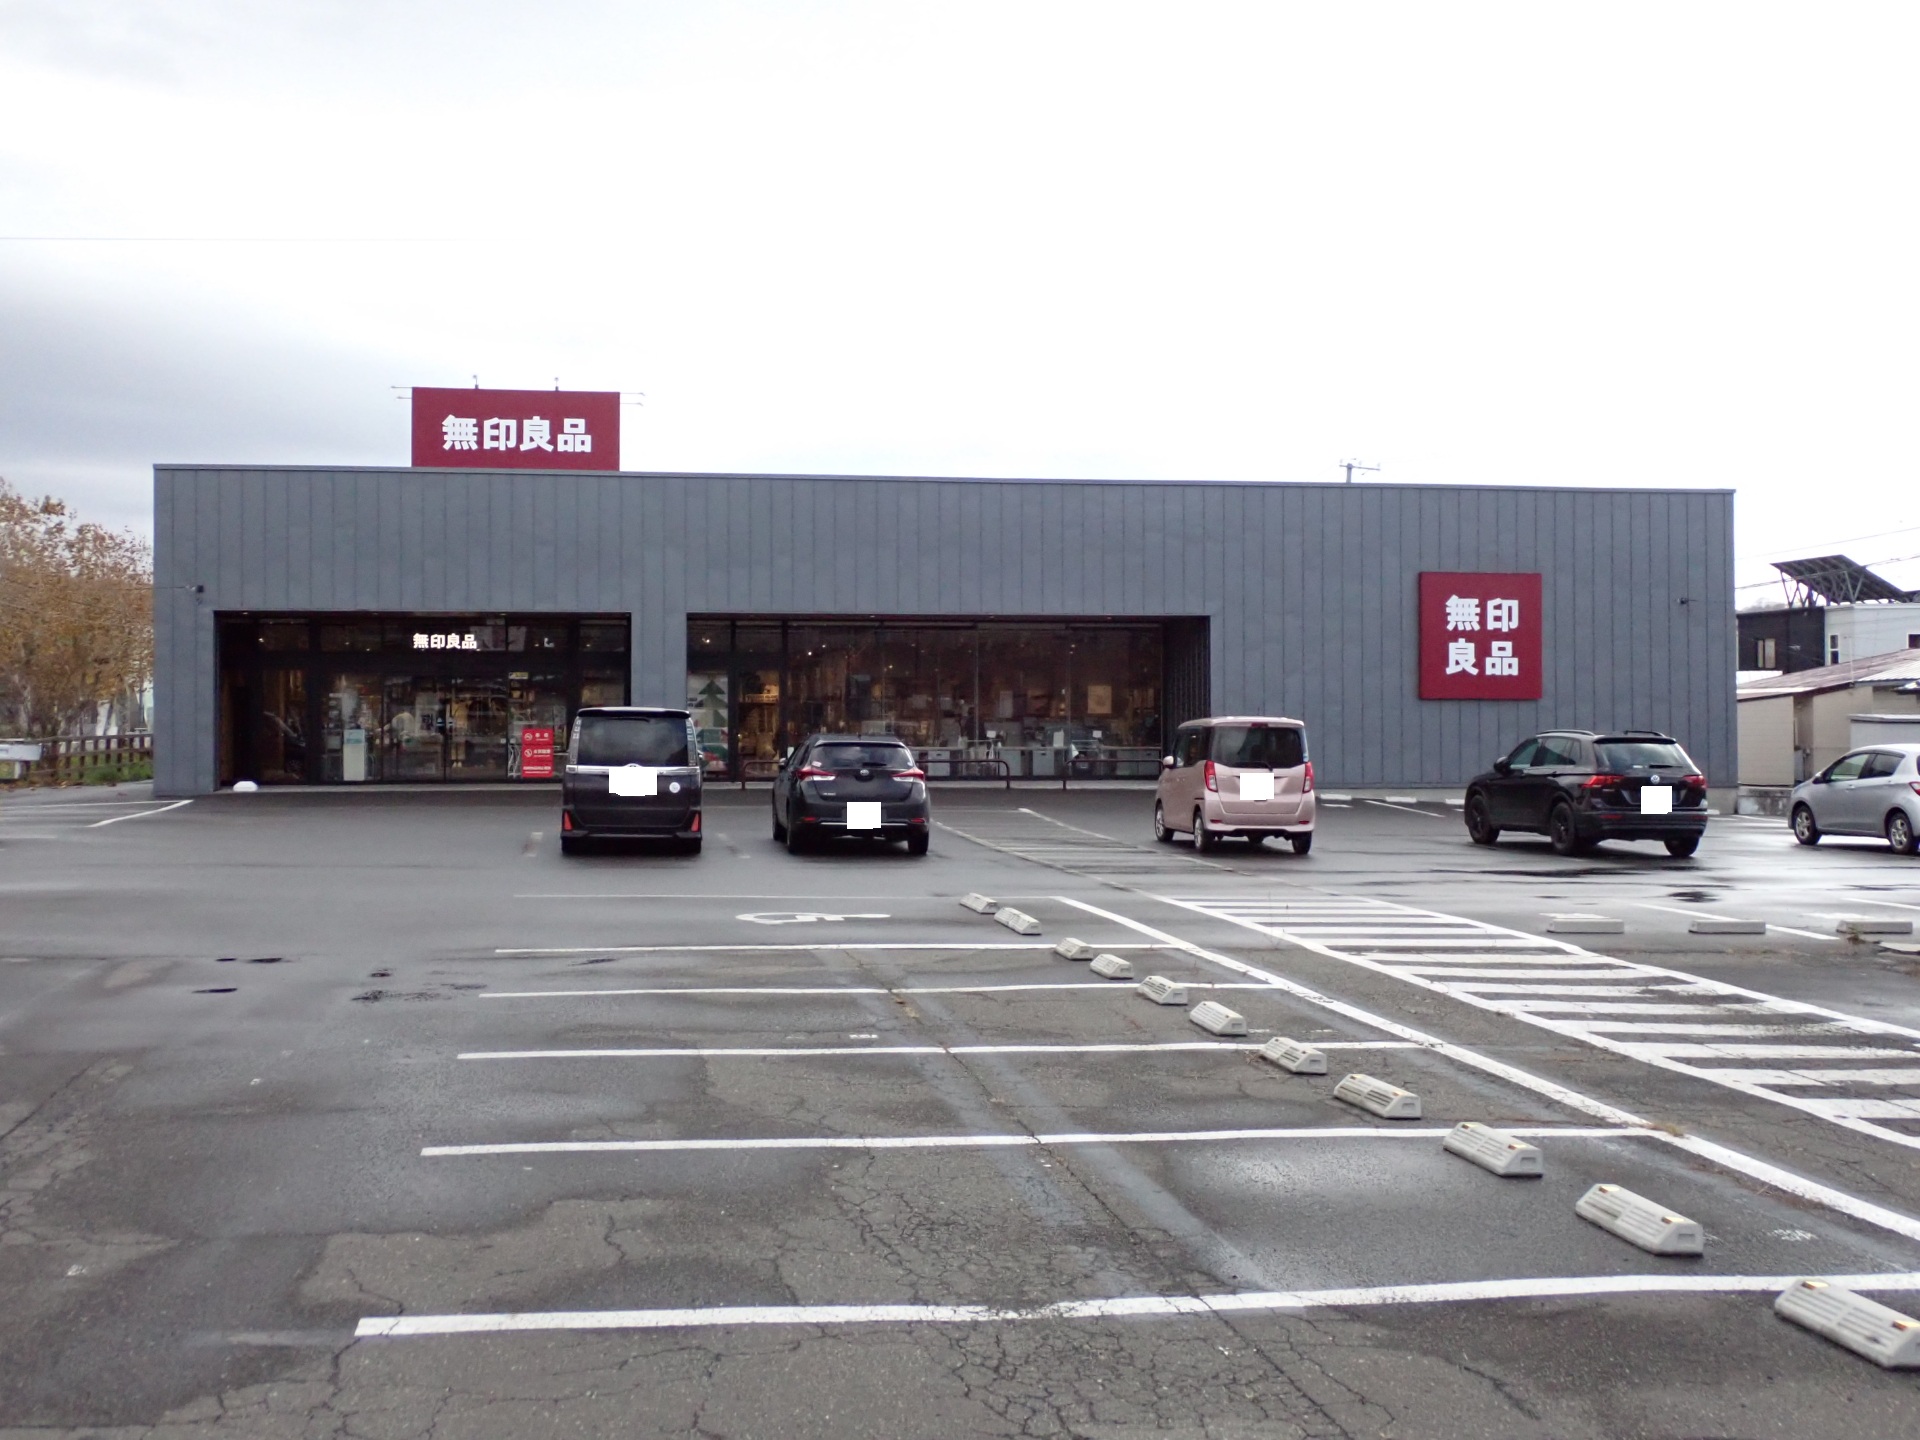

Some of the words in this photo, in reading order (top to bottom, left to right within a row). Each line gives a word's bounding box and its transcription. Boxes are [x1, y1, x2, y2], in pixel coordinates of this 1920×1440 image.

[441, 414, 592, 453] 無印良品
[1446, 595, 1519, 632] 無印
[413, 632, 477, 649] 無印良品
[1446, 638, 1519, 676] 良品
